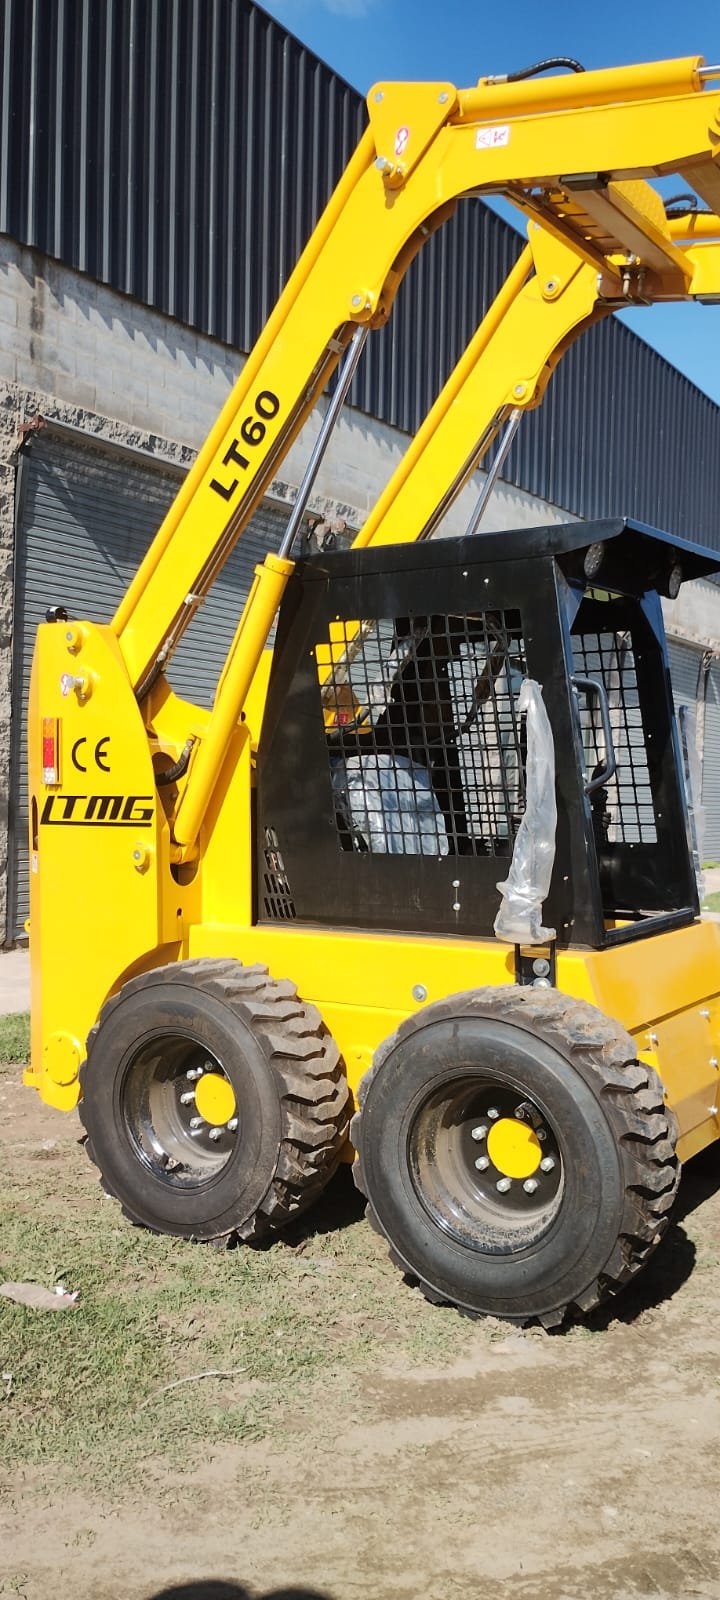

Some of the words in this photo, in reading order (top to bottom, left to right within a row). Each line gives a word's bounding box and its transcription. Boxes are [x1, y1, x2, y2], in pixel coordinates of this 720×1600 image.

[209, 390, 280, 502] LT60
[71, 736, 111, 772] CE
[40, 795, 154, 826] LTMG
